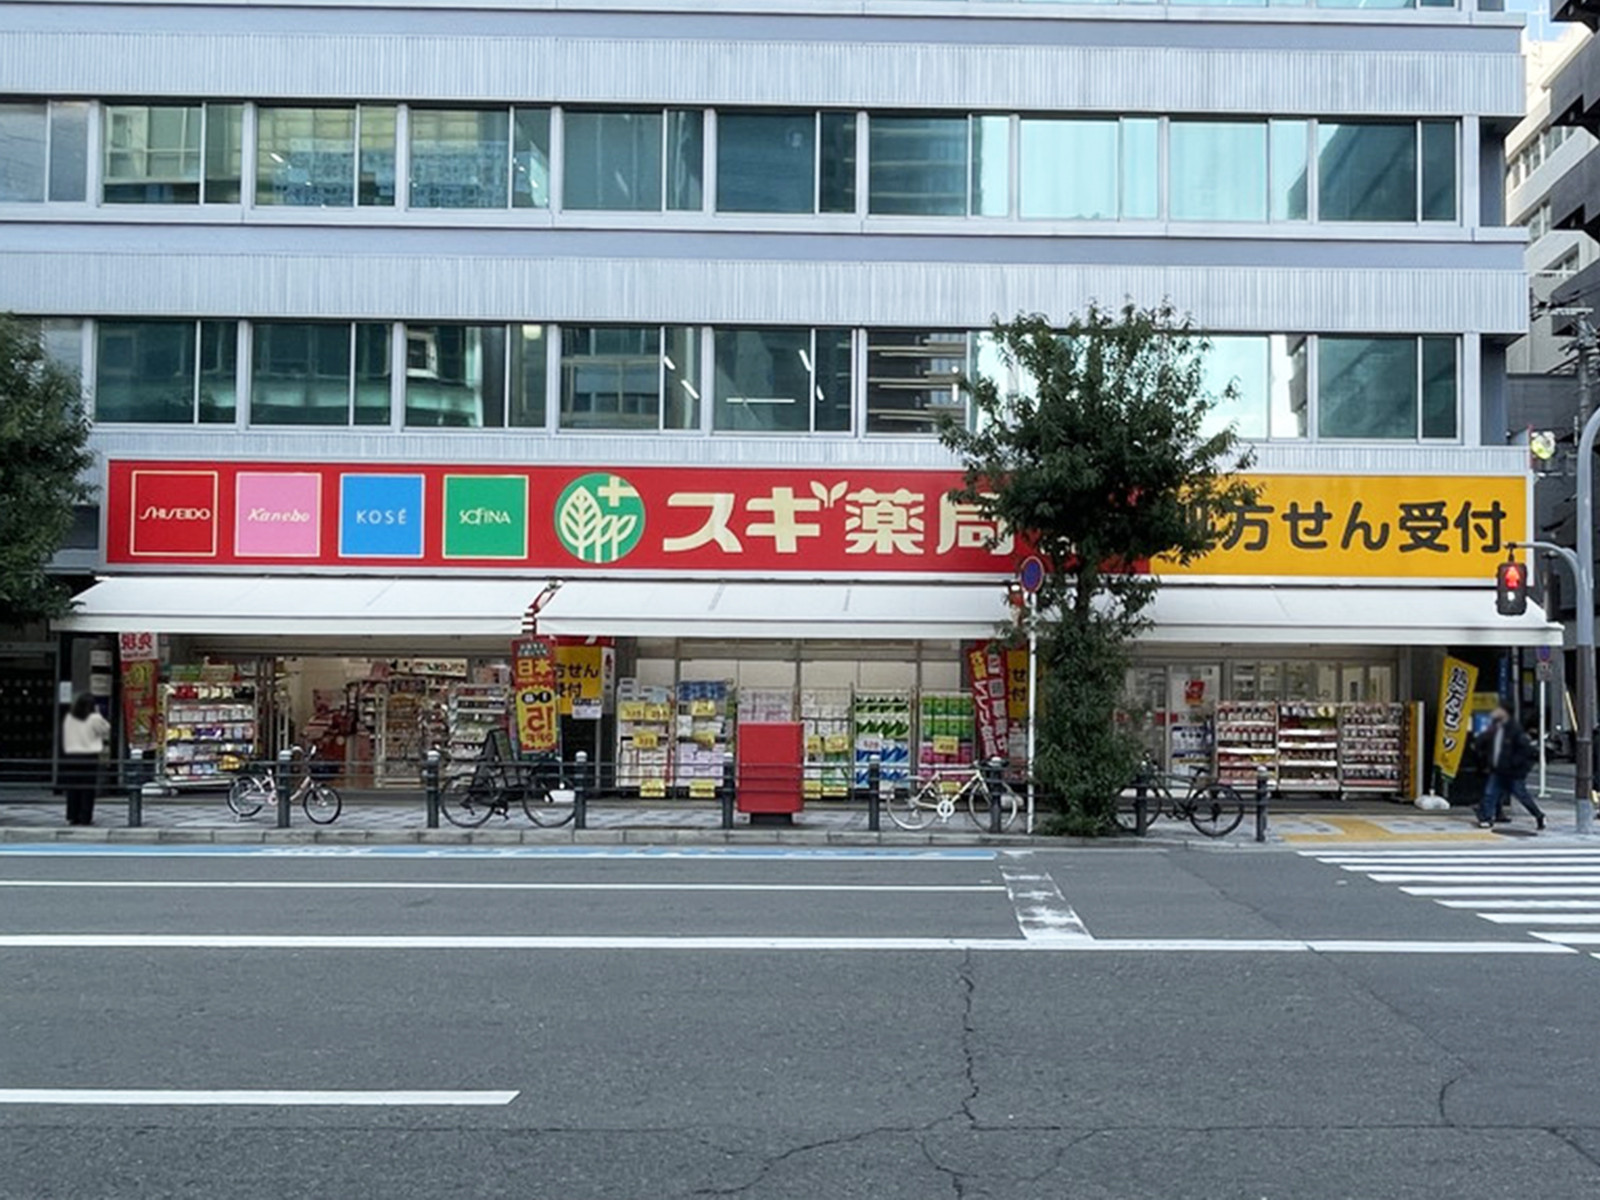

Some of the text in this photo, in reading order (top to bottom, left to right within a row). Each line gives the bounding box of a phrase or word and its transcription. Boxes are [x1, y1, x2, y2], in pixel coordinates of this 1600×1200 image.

[139, 506, 211, 521] SHISEIDO
[247, 507, 310, 523] Kanebo
[356, 508, 407, 526] KOSÉ
[663, 481, 1016, 557] スギ薬局
[1180, 499, 1507, 553] 方せん受付
